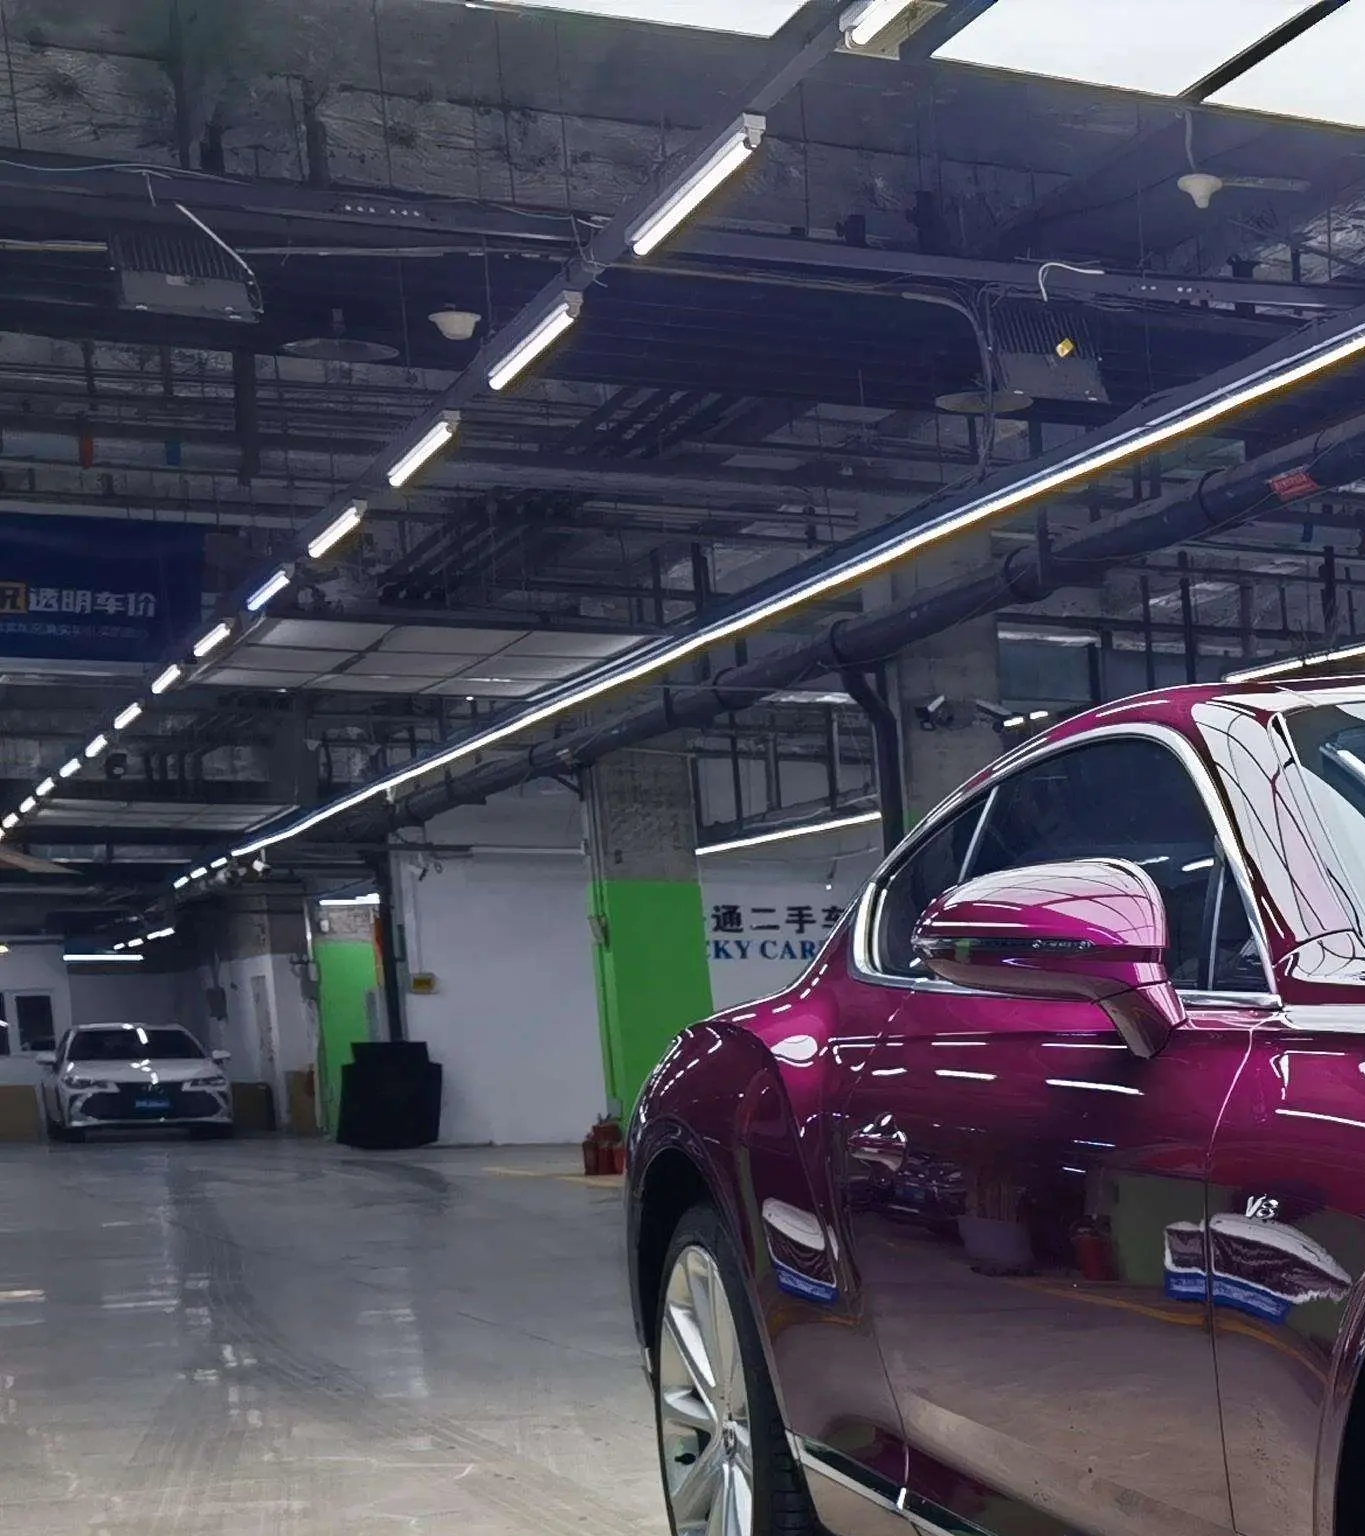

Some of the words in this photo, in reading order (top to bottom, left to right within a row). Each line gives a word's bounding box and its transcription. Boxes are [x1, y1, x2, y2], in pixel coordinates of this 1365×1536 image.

[29, 587, 156, 617] 透明车价
[707, 940, 750, 960] KY
[1245, 1193, 1280, 1220] V8
